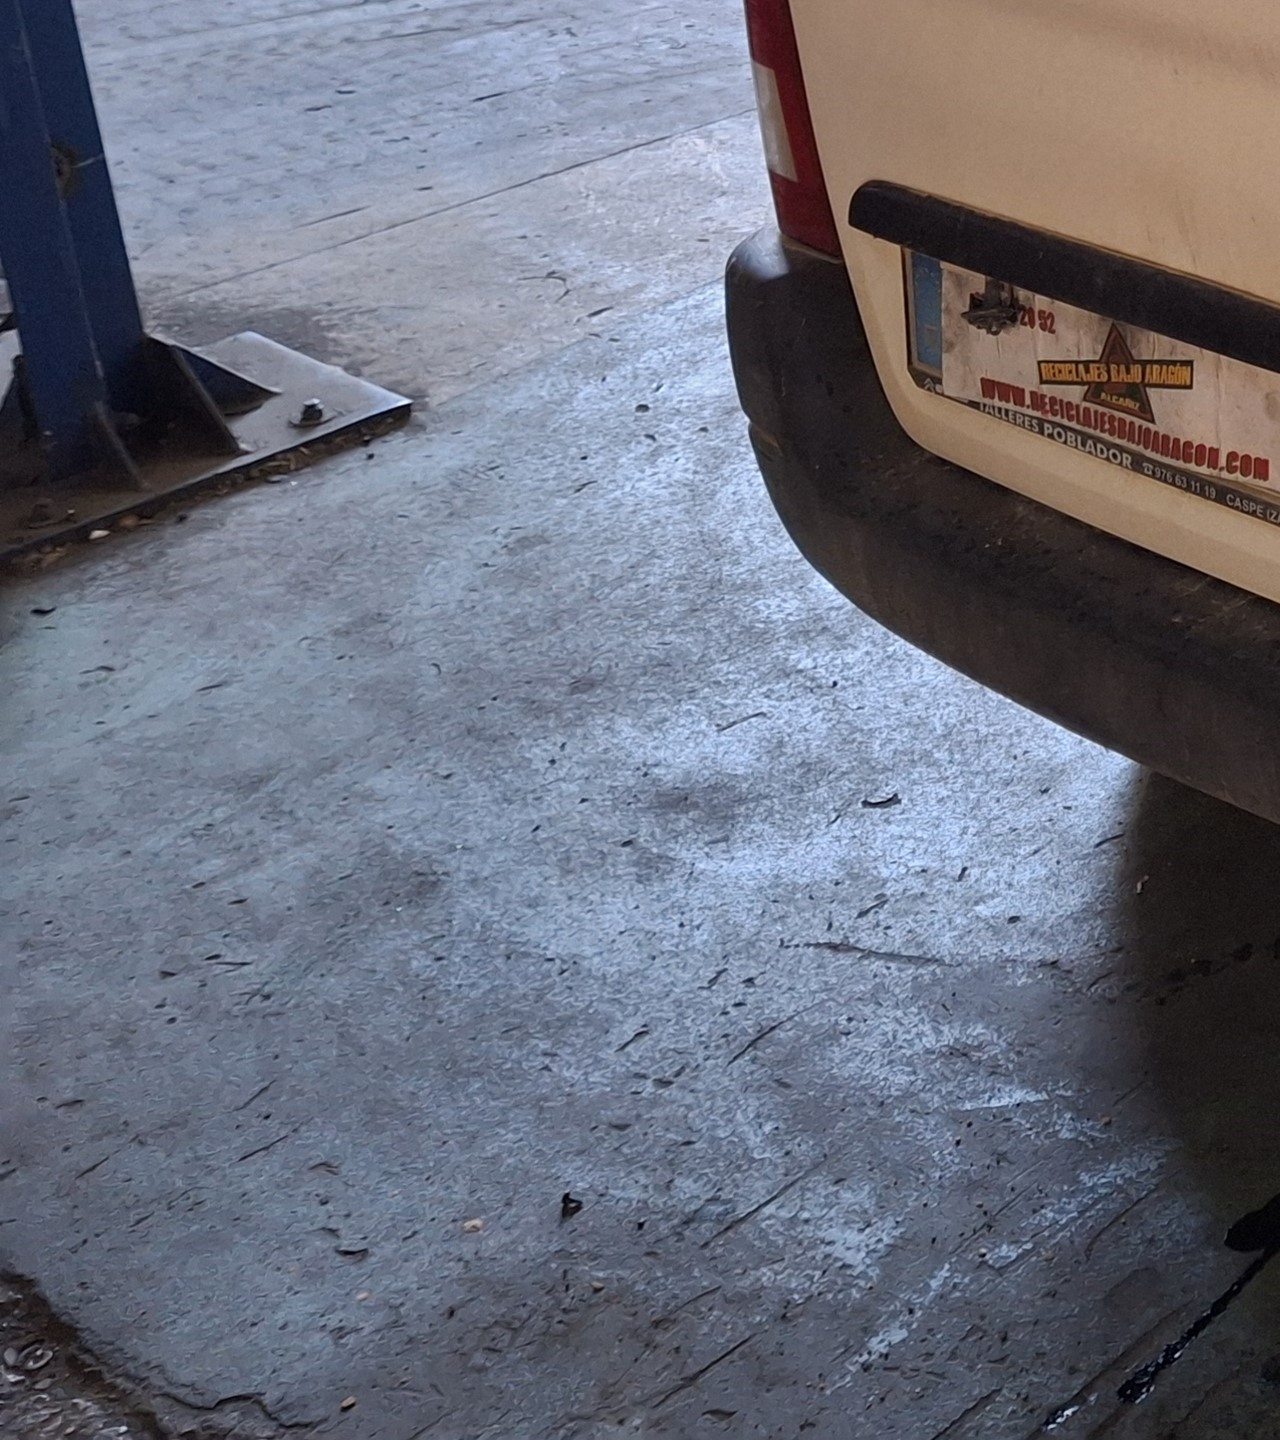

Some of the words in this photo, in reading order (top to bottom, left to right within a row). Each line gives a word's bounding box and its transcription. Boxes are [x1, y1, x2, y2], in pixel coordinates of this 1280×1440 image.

[1040, 362, 1108, 383] RECICLAJES
[1110, 363, 1142, 384] BAJO
[1044, 423, 1133, 470] POBLADOR
[1154, 467, 1173, 483] 976
[1174, 473, 1188, 489] 63
[1190, 480, 1201, 495] 11
[1204, 485, 1217, 500] 19
[1226, 493, 1265, 517] CASPE
